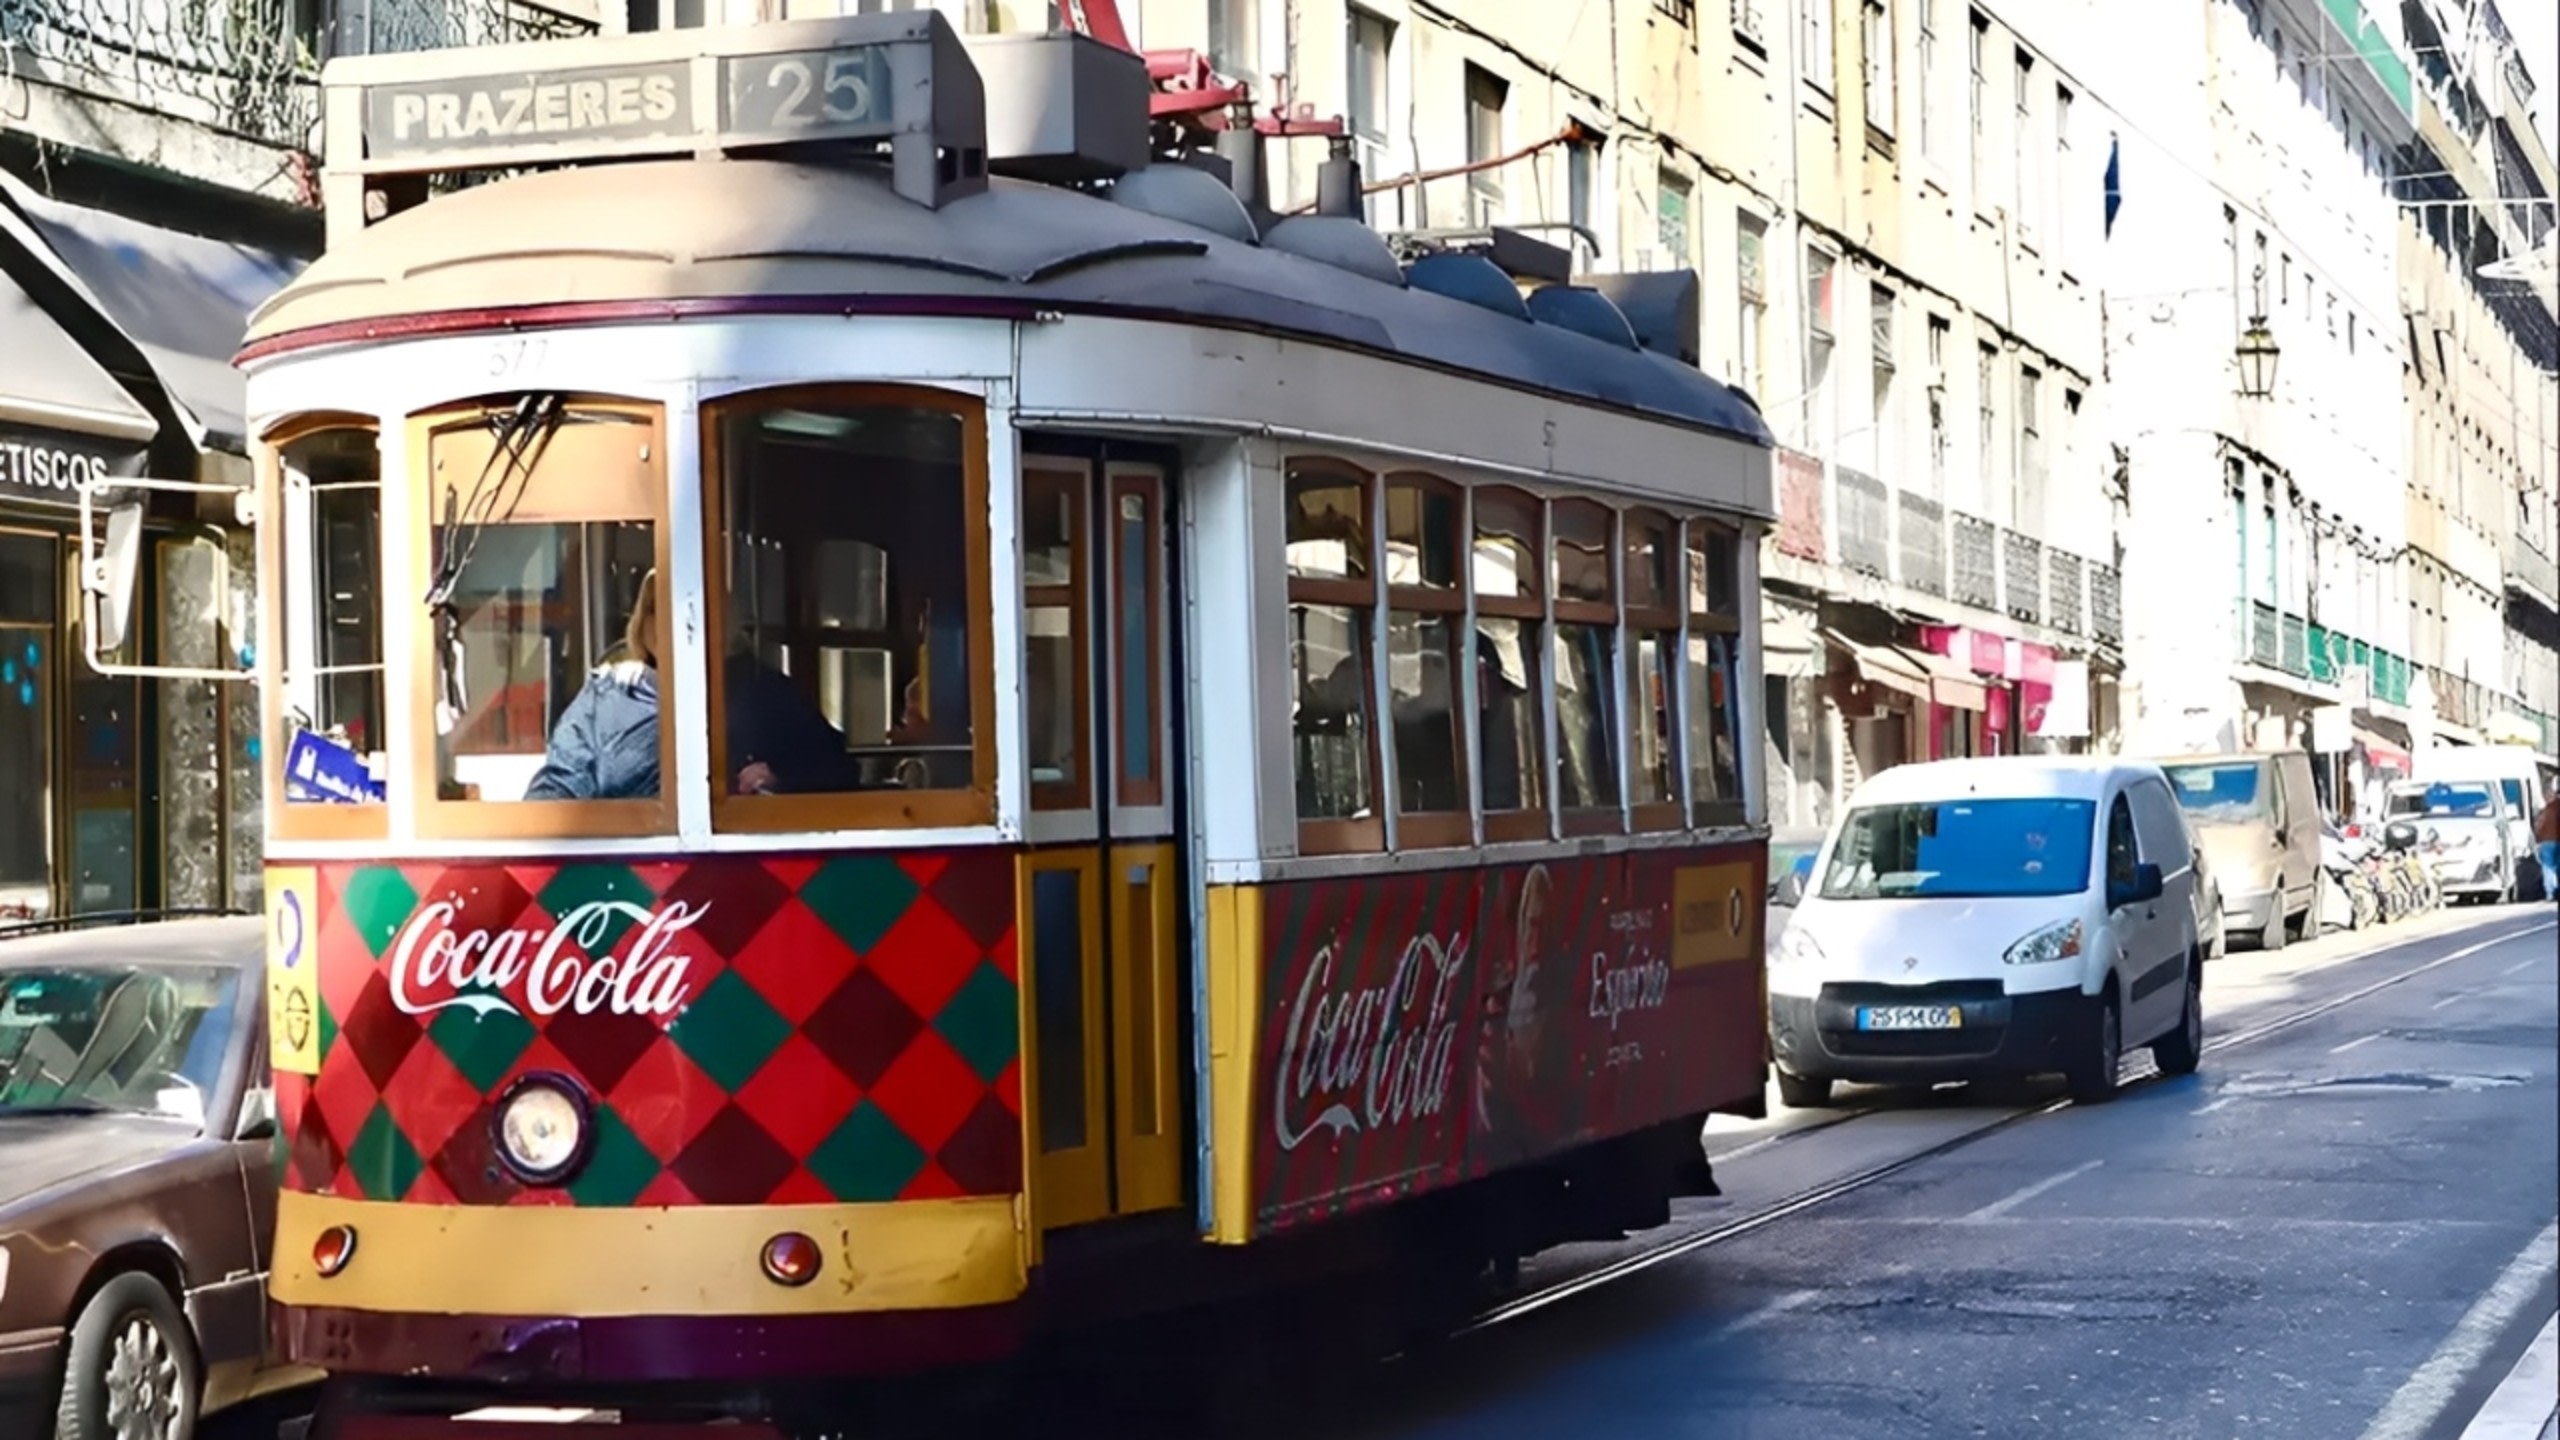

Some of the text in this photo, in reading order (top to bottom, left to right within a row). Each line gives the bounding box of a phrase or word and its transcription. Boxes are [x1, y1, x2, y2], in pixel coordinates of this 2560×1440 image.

[392, 55, 870, 141] PRAZERES 25
[389, 900, 712, 1016] Coca-Cola
